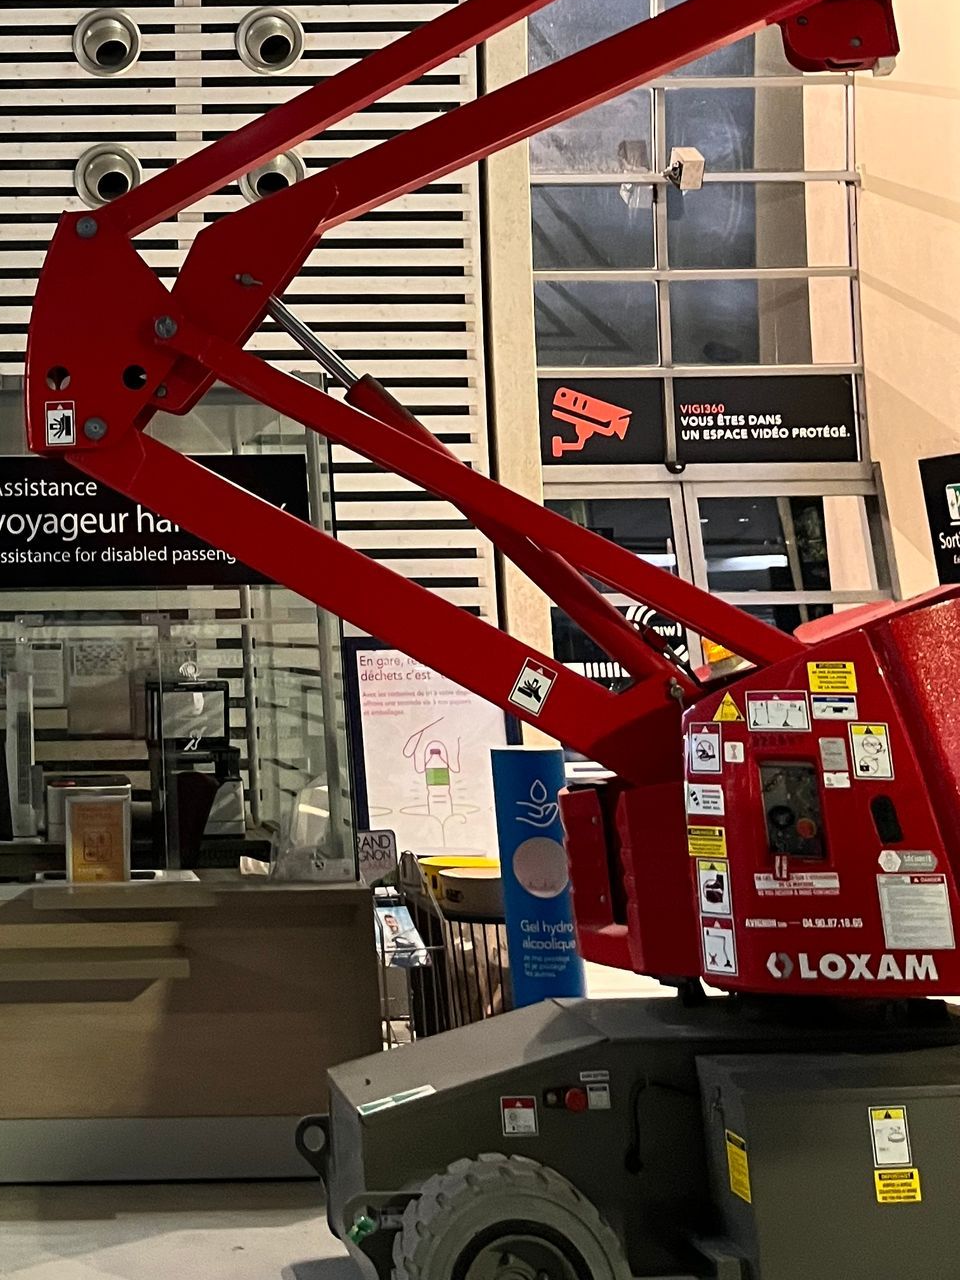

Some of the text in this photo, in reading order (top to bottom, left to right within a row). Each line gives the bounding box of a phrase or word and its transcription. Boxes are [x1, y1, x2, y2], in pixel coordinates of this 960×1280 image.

[680, 404, 725, 414] VIGI360
[680, 414, 782, 426] VOUS ÊTES DANS
[681, 425, 851, 440] UN ESPACE VIDÉO PROTÉGÉ.
[939, 529, 960, 549] Sort
[75, 547, 96, 562] for
[101, 546, 168, 562] disabled
[172, 548, 237, 564] passeng
[360, 656, 373, 666] En
[377, 657, 404, 669] gare,
[361, 670, 403, 681] déchets
[521, 920, 574, 935] Gel hydro
[523, 935, 576, 952] alcoolique
[798, 953, 939, 980] LOXAM
